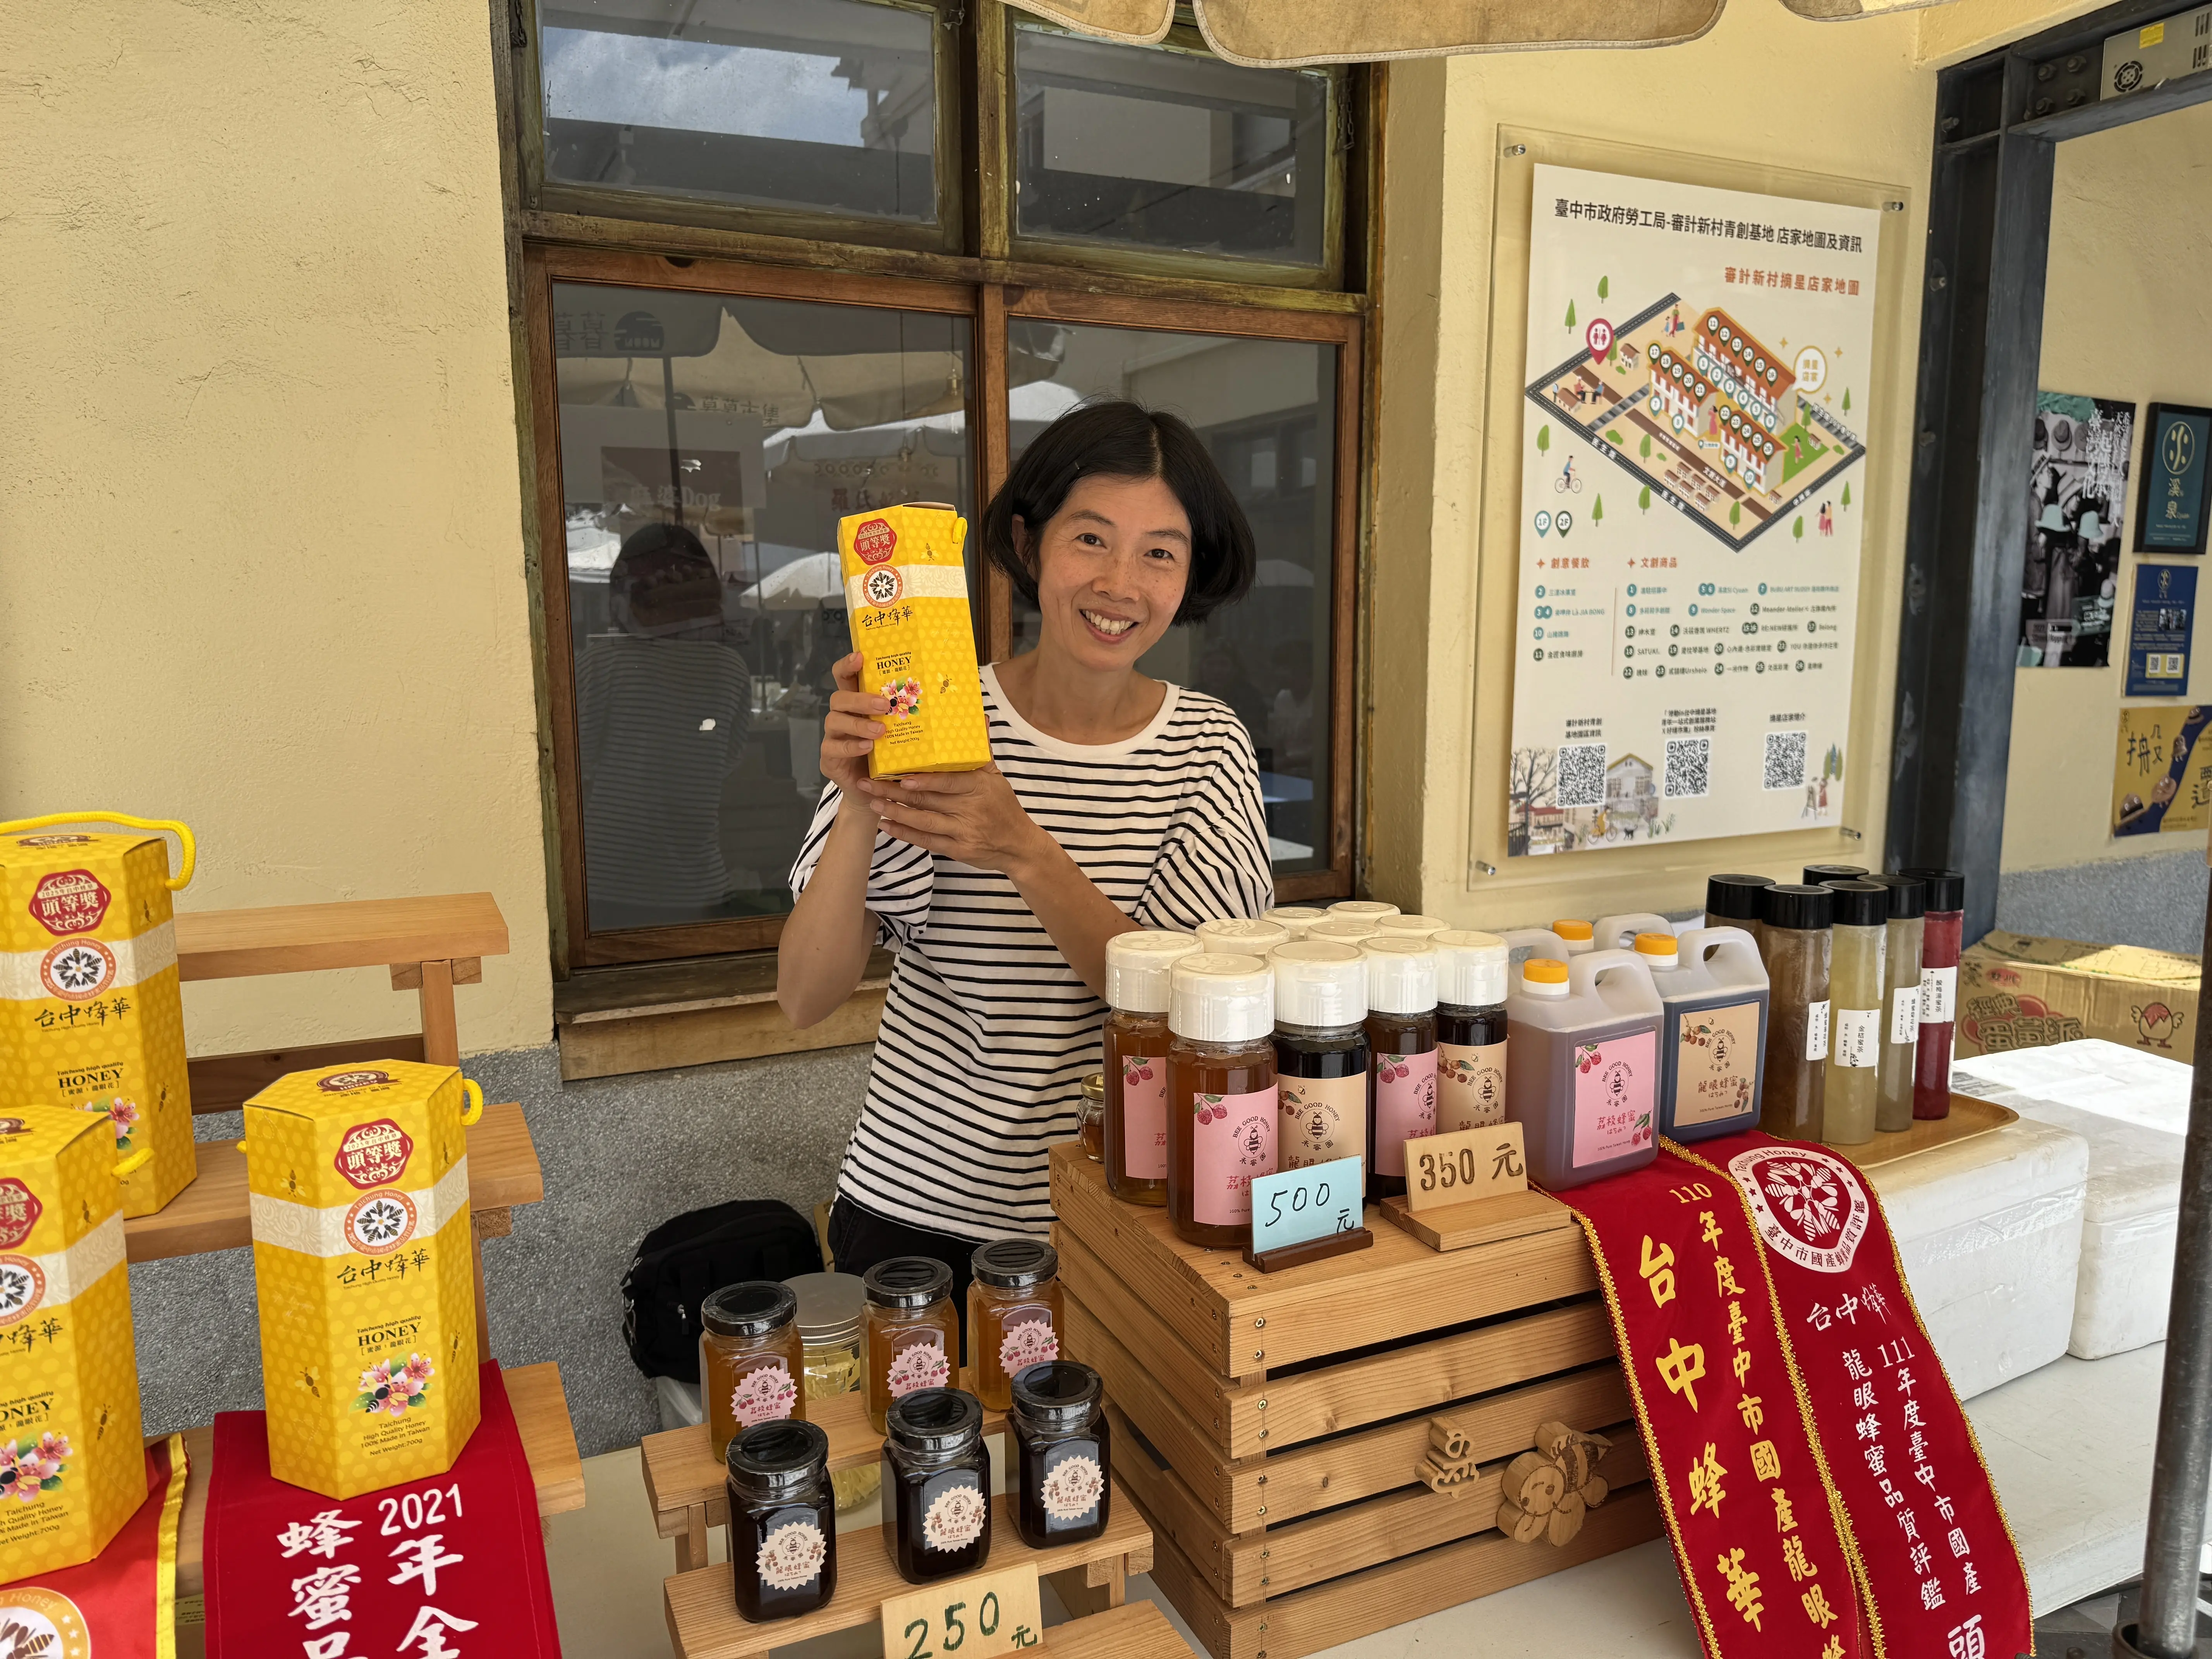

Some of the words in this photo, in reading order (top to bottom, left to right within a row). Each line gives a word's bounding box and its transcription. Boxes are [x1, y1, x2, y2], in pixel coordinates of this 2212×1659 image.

[1538, 518, 1547, 526] 1F
[1560, 518, 1569, 526] 2F
[1641, 557, 1677, 568] 文創商品
[877, 656, 911, 670] HONEY
[41, 892, 99, 917] 頭等獎
[50, 940, 79, 956] Taichung
[81, 939, 103, 950] Honey
[1712, 1029, 1725, 1037] GOOD
[1726, 1030, 1736, 1045] HONEY
[57, 1068, 85, 1076] Taichung
[101, 1061, 124, 1070] quality
[1467, 1075, 1476, 1086] BEE
[1477, 1067, 1492, 1076] GOOD
[1494, 1068, 1503, 1083] HONEY
[1609, 1061, 1621, 1071] GOOD
[1622, 1062, 1633, 1077] HONEY
[58, 1068, 124, 1089] HONEY
[1698, 1075, 1738, 1093] 龍眼蜂蜜
[1295, 1108, 1304, 1120] BEE
[1324, 1104, 1340, 1121] HONEY
[1597, 1109, 1635, 1130] 荔枝蜂蜜
[1233, 1126, 1242, 1138] BEE
[1242, 1116, 1258, 1126] GOOD
[1260, 1116, 1271, 1133] HONEY
[347, 1141, 402, 1170] 頭等獎
[1735, 1152, 1765, 1173] Taichung
[1765, 1149, 1807, 1158] Honey
[1420, 1148, 1476, 1191] 350
[1492, 1142, 1524, 1180] 元
[354, 1192, 383, 1209] Taichung
[385, 1191, 405, 1200] Honey
[1669, 1183, 1712, 1204] 110
[1265, 1183, 1331, 1228] 500
[1337, 1208, 1355, 1233] 元
[357, 1323, 384, 1334] Taichung
[400, 1315, 421, 1324] quality
[358, 1322, 421, 1346] HONEY
[1877, 1336, 1915, 1368] 111
[769, 1374, 779, 1384] HONEY
[9, 1397, 26, 1405] high
[28, 1391, 54, 1401] quality
[363, 1432, 379, 1441] High
[381, 1426, 404, 1436] Quality
[405, 1420, 426, 1429] Honey
[379, 1417, 411, 1429] Taichung
[361, 1439, 378, 1449] 100%
[380, 1436, 398, 1444] Made
[407, 1426, 430, 1436] Taiwan
[1639, 1235, 1762, 1633] 台中蜂華
[1842, 1349, 1946, 1611] 龍眼蜂蜜品質評鑑
[5, 1502, 45, 1516] Taichung
[8, 1512, 36, 1524] Quality
[38, 1504, 64, 1516] Honey
[378, 1483, 462, 1536] 2021
[7, 1523, 29, 1533] Made
[41, 1510, 69, 1522] Taiwan
[798, 1532, 808, 1541] HONEY
[10, 1593, 58, 1612] Honey
[905, 1592, 1000, 1659] 250
[1011, 1625, 1037, 1649] 元
